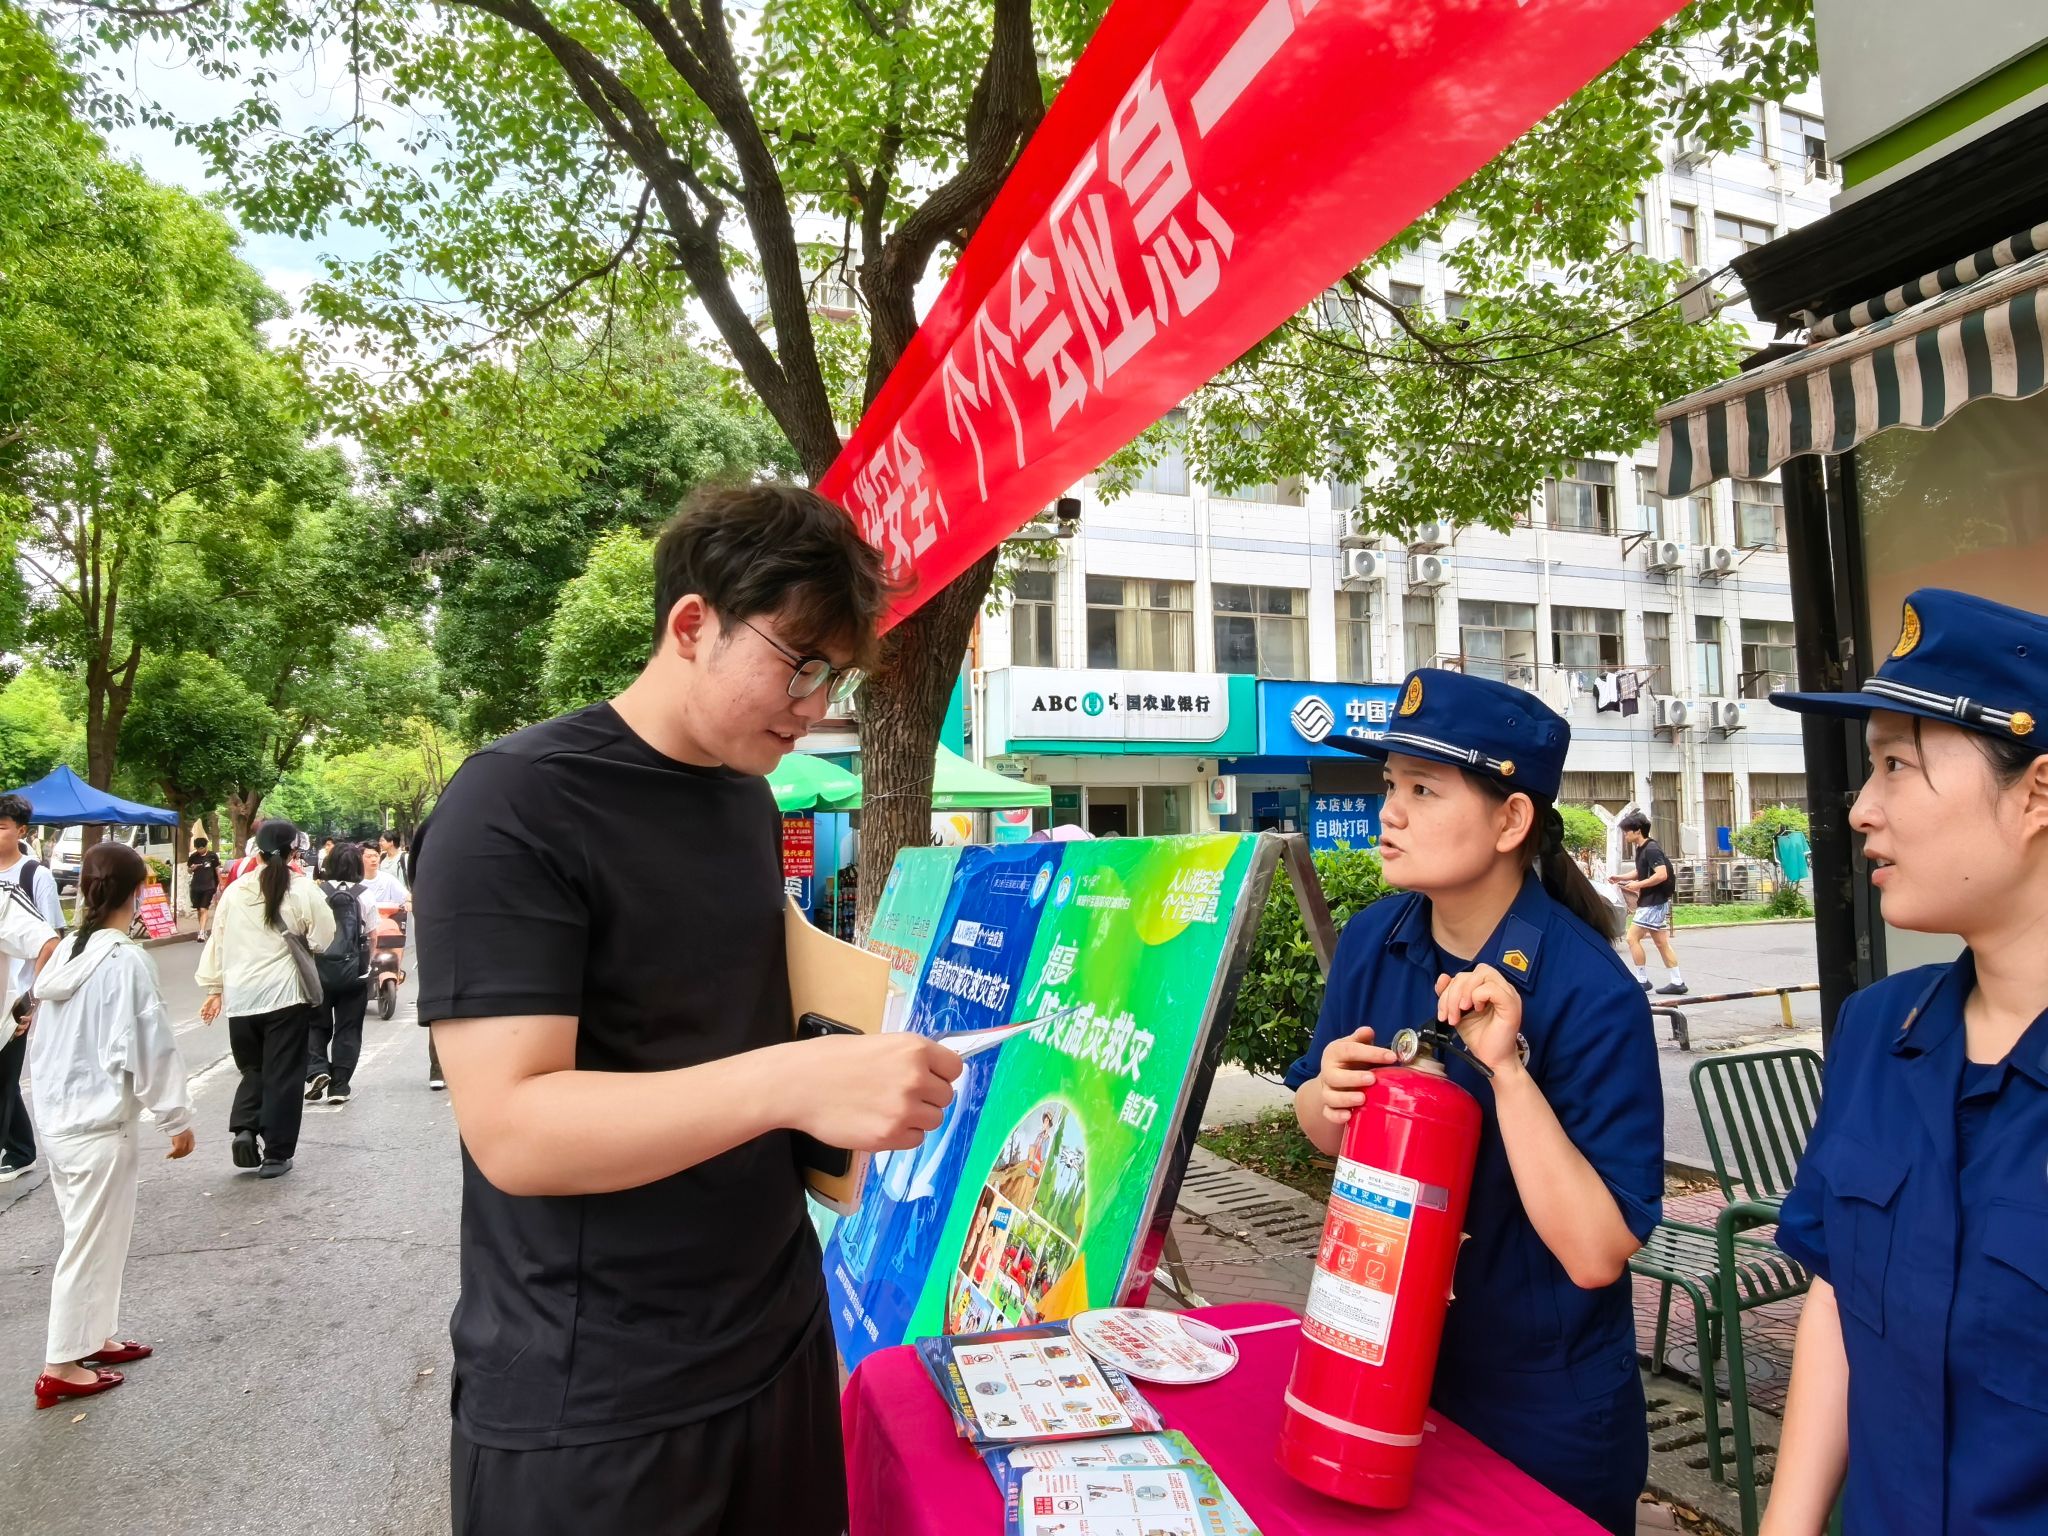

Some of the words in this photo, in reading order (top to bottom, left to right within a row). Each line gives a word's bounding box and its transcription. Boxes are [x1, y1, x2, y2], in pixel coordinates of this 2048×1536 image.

[1032, 695, 1077, 712] ABC
[1316, 798, 1366, 812] 本店业务
[1315, 819, 1369, 838] 自助打印
[1028, 990, 1156, 1082] 防灾减灾救灾
[1117, 1089, 1159, 1132] 能力
